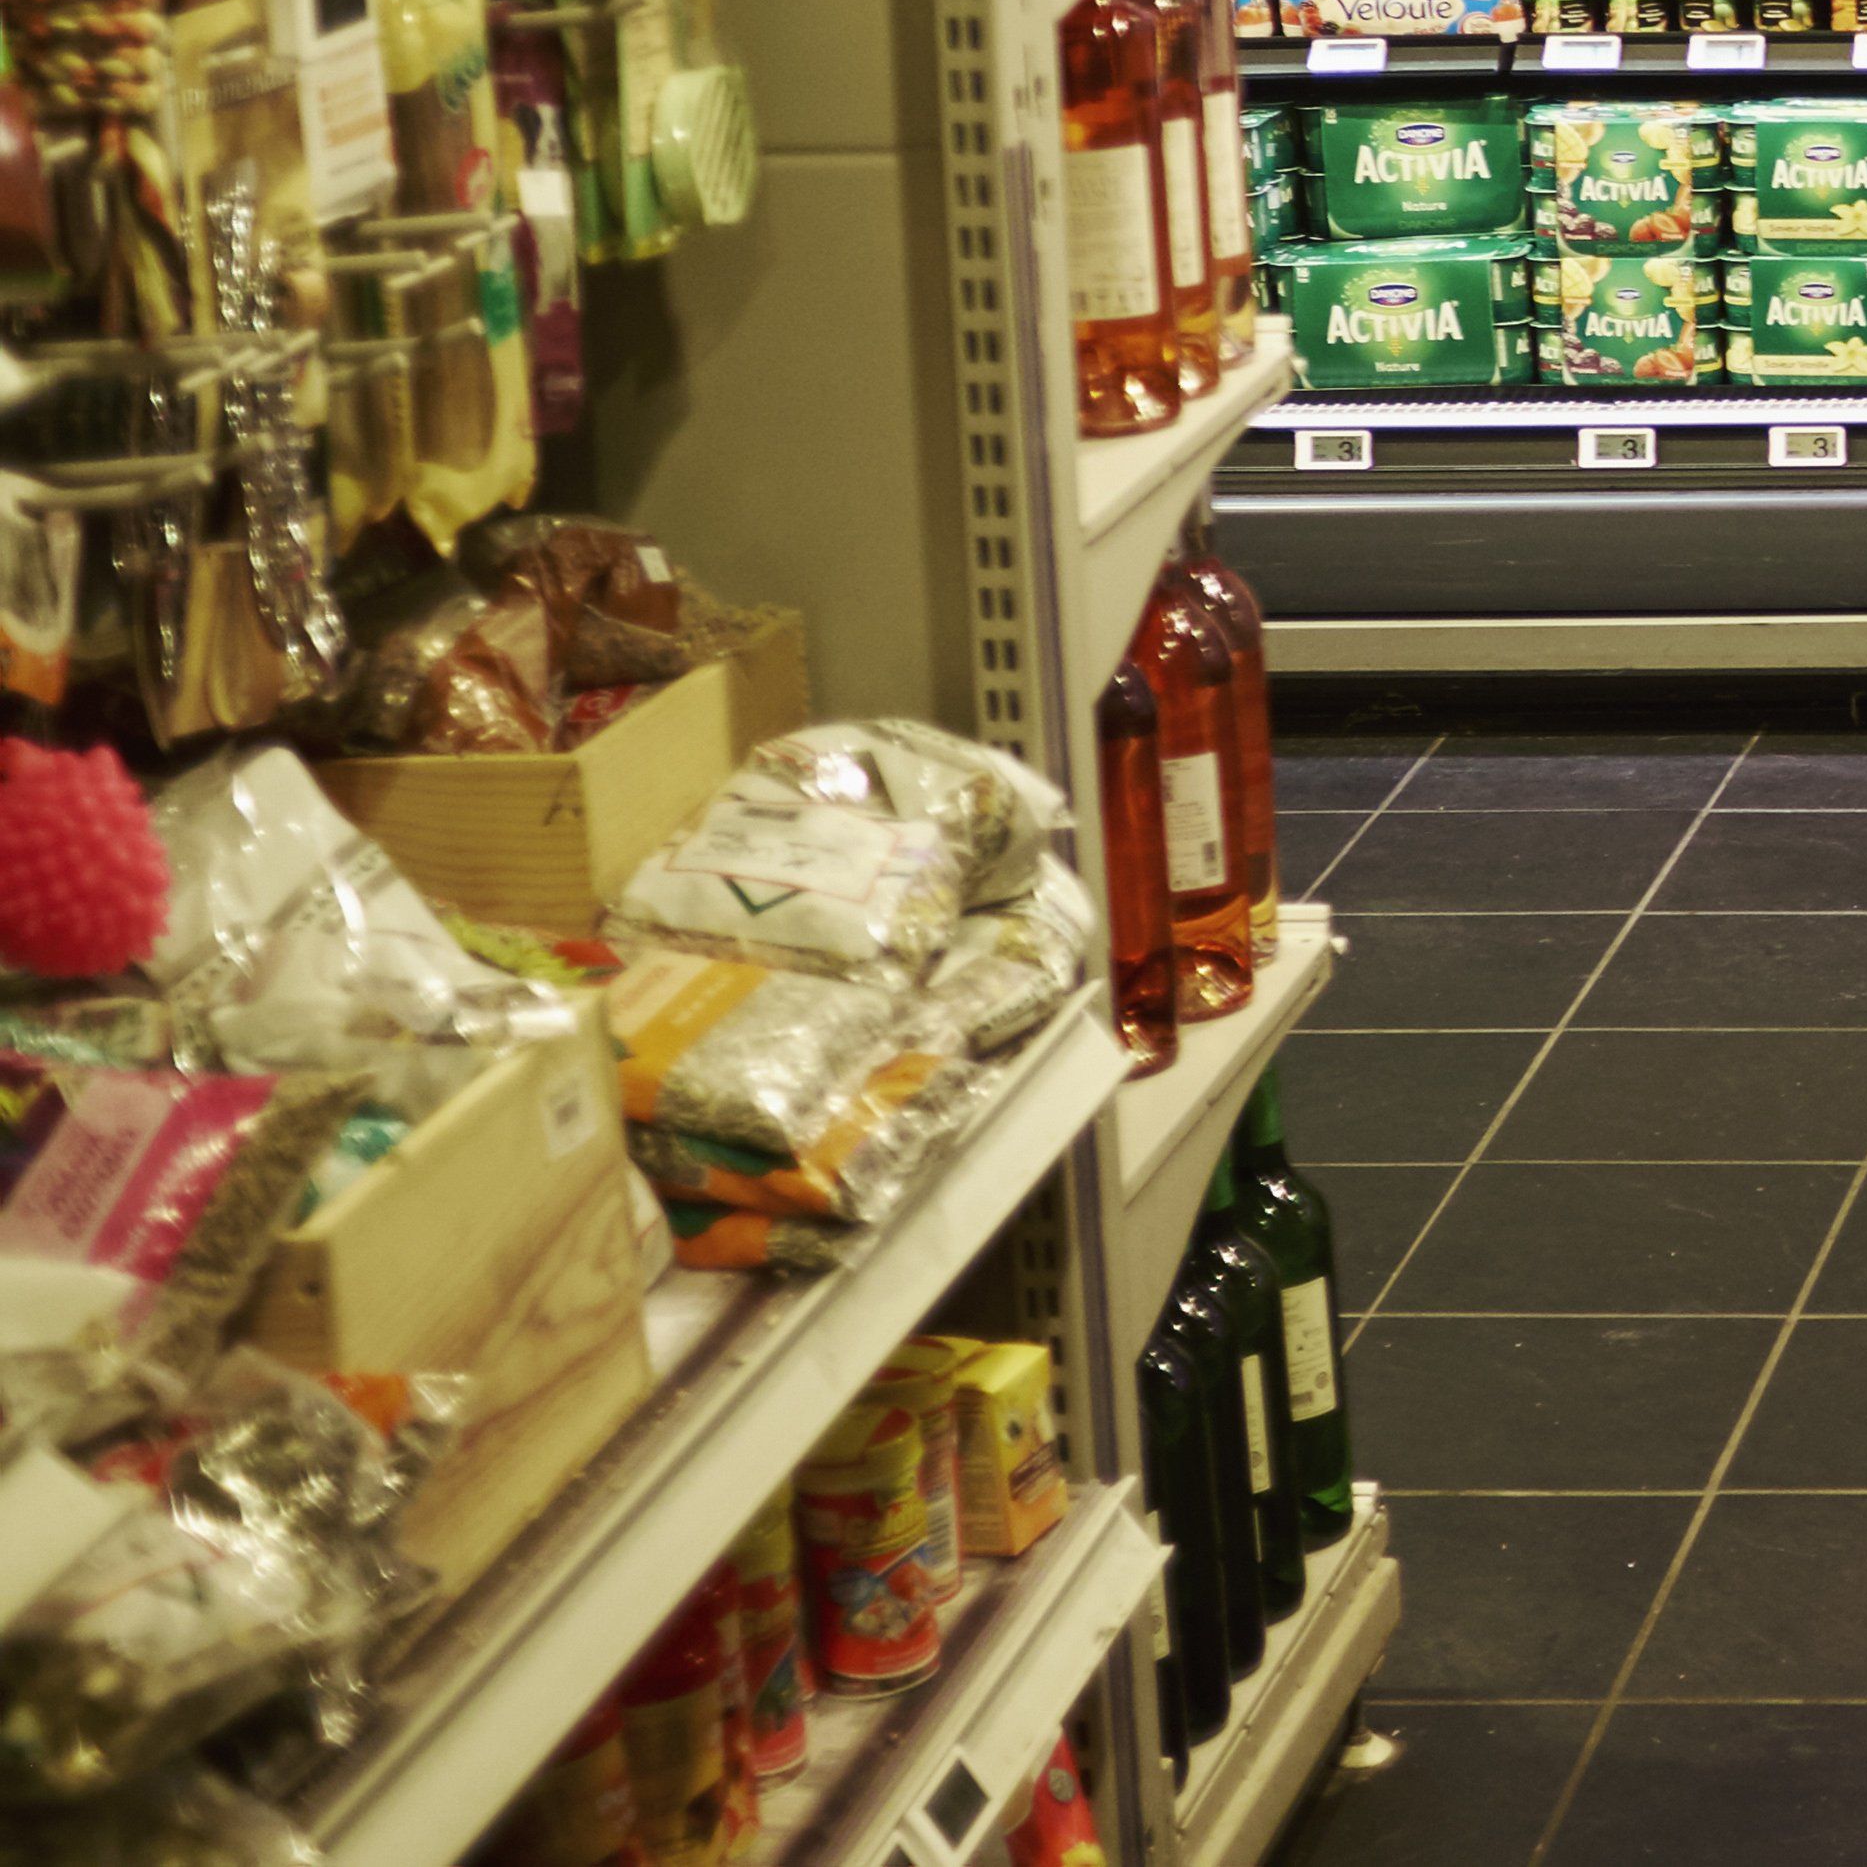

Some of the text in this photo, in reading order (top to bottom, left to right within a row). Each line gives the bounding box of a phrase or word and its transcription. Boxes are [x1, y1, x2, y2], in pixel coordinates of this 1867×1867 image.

[1354, 141, 1491, 184] ACTIVIA
[1580, 175, 1669, 202] ACTIVIA
[1402, 201, 1447, 212] Nature
[1327, 301, 1464, 344] ACTIVIA
[1585, 312, 1673, 338] ACTIVIA
[1766, 295, 1867, 327] ACTIVIA
